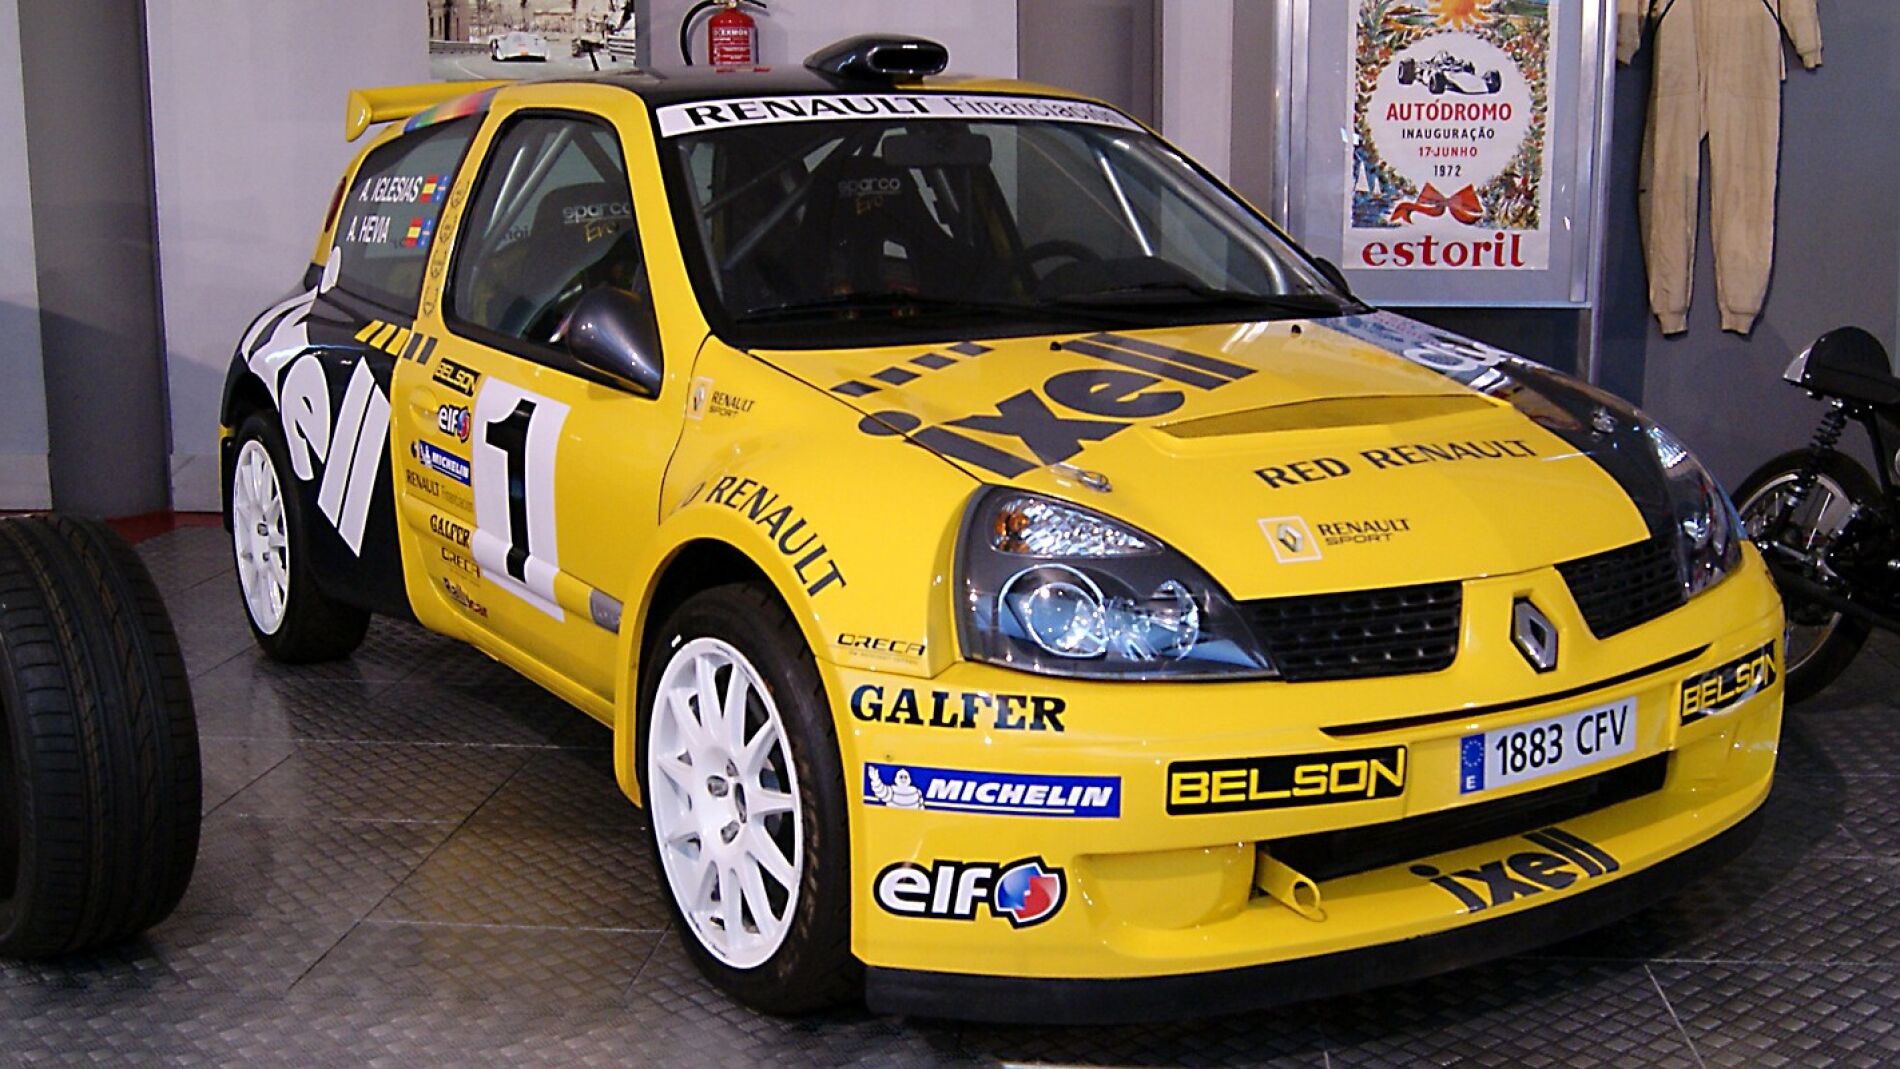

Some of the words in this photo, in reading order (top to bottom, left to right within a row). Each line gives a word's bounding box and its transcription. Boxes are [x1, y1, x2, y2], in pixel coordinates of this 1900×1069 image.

[685, 97, 929, 126] RENAULT
[1386, 98, 1513, 121] AUTÓDROMO
[1402, 127, 1495, 142] INAUGURAÇÃO
[1434, 165, 1462, 177] 1972
[371, 175, 423, 203] IGLESIAS
[1361, 231, 1527, 267] estoril
[434, 361, 478, 394] BELSON
[711, 390, 755, 412] RENAULT
[858, 332, 1259, 479] ixell
[438, 406, 459, 434] elf
[432, 451, 470, 479] MICHELIN
[1254, 457, 1351, 489] RED
[1360, 440, 1537, 469] RENAULT
[406, 469, 439, 497] RENAULT
[485, 397, 537, 583] 1
[430, 514, 470, 549] GALFER
[705, 476, 847, 597] RENAULT
[1318, 518, 1411, 537] RENAULT
[1325, 533, 1393, 545] SPORT
[838, 633, 925, 656] ORECA
[1682, 653, 1777, 717] BELSON
[850, 684, 1066, 732] GALFER
[1496, 723, 1563, 776] 1883
[1577, 705, 1628, 755] CFV
[1171, 748, 1405, 805] BELSON
[1466, 775, 1476, 790] E
[926, 778, 1113, 807] MICHELIN
[1409, 827, 1620, 913] ixell
[879, 865, 992, 915] elf
